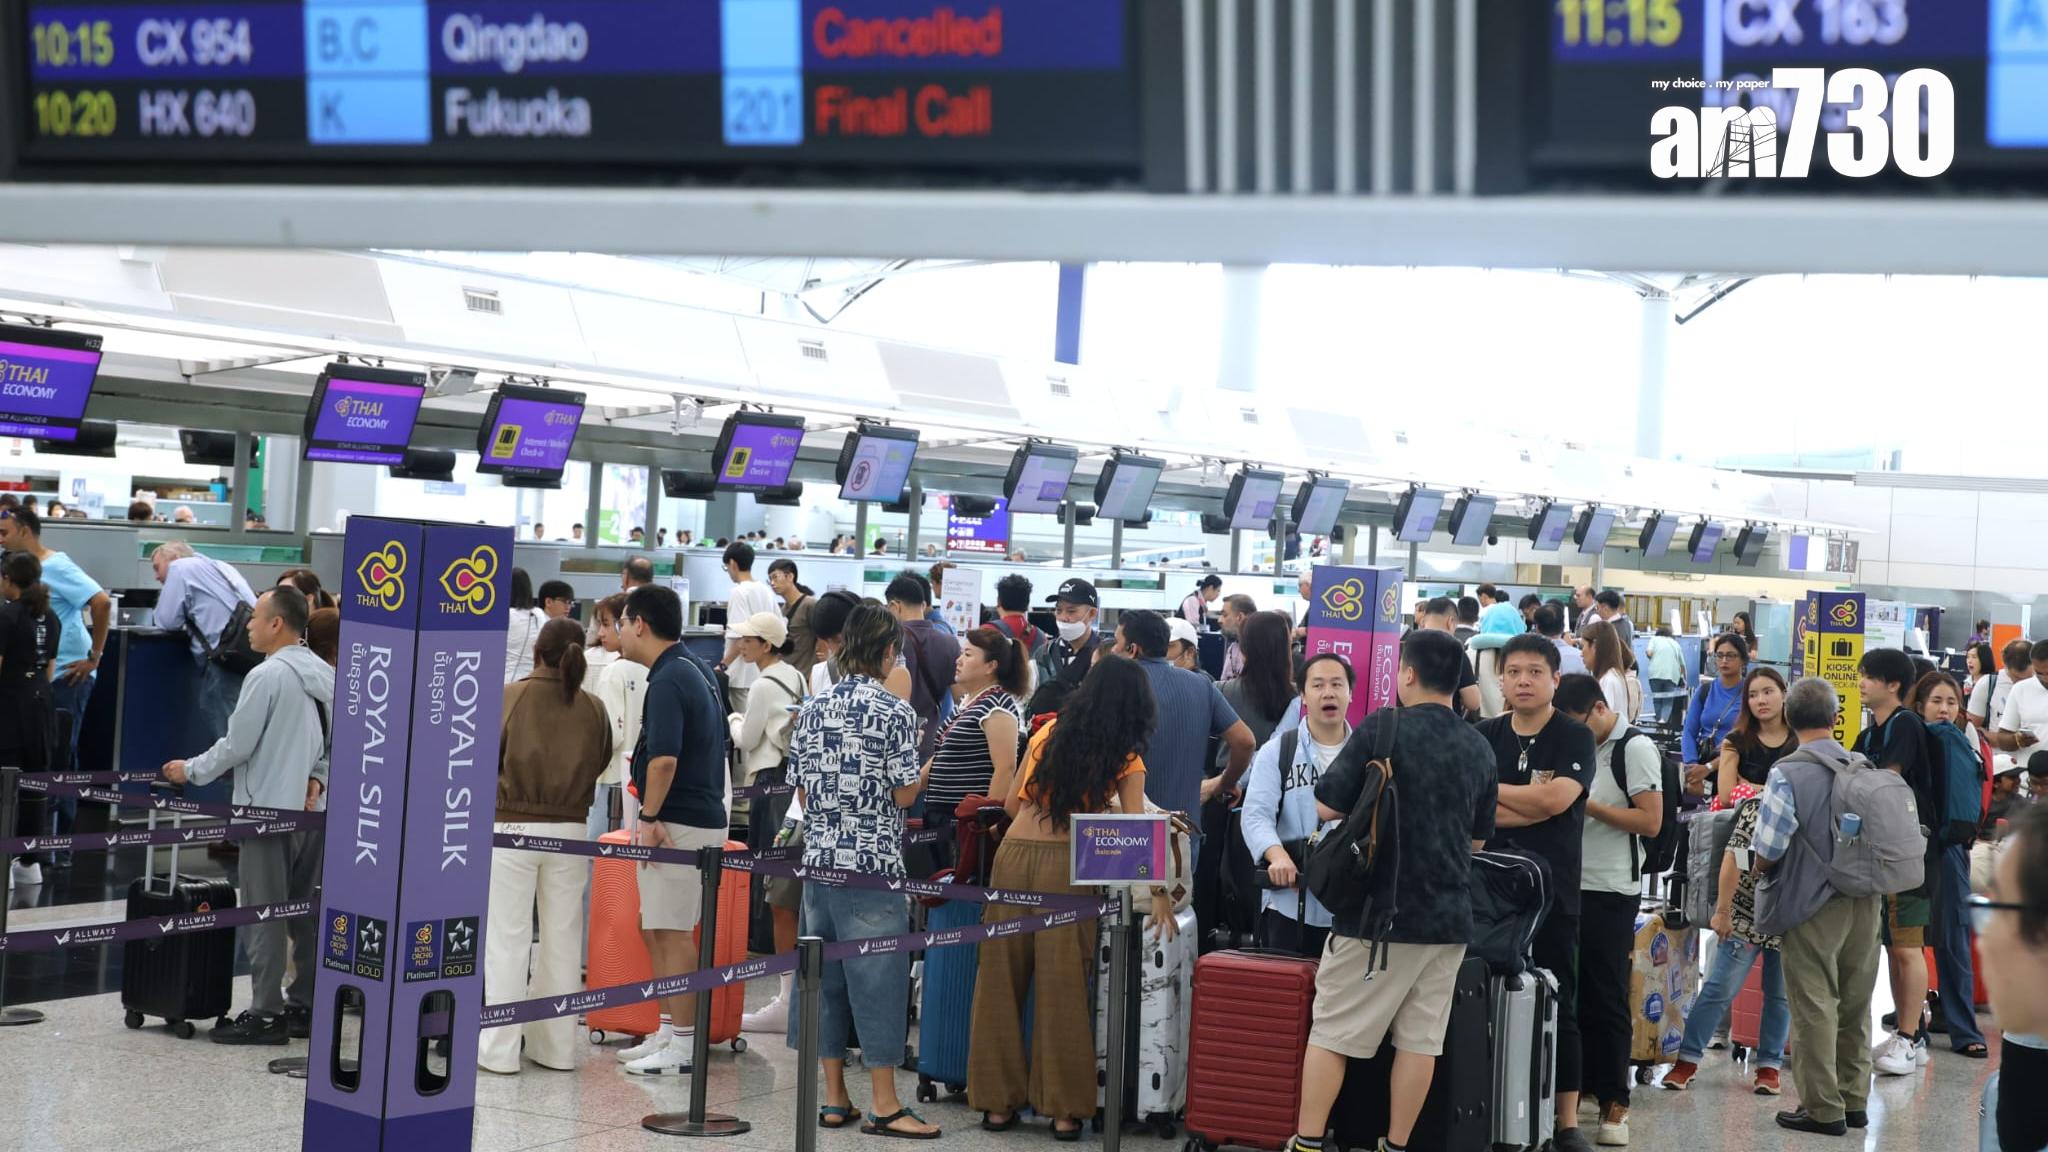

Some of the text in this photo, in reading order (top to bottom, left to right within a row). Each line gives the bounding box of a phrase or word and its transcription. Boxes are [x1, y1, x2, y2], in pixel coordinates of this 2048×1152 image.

[1558, 0, 1683, 47] 11:15
[1723, 0, 1805, 46] CX
[813, 7, 1001, 57] Cancelled
[32, 21, 114, 66] 10:15
[137, 19, 252, 64] CX 954
[442, 14, 589, 72] Qingdao
[34, 91, 116, 136] 10:20
[140, 91, 256, 136] HX 640
[318, 91, 346, 136] K
[445, 89, 592, 137] Fukuoka
[731, 88, 797, 135] 201
[814, 84, 993, 136] Final Call
[9, 365, 49, 385] THAI
[2, 383, 58, 400] ECONOMY
[352, 400, 384, 416] THAI
[346, 416, 390, 430] ECONOMY
[356, 593, 379, 608] THAI
[439, 602, 466, 615] THAI
[1321, 610, 1341, 619] THAI
[1823, 672, 1858, 681] ONLINE
[355, 644, 392, 867] ROYAL SILK
[440, 650, 481, 872] ROYAL SILK
[19, 778, 48, 788] ALLWAYS
[93, 790, 123, 800] ALLWAYS
[169, 801, 200, 810] ALLWAYS
[247, 809, 279, 818] ALLWAYS
[196, 827, 226, 836] ALLWAYS
[269, 821, 297, 830] ALLWAYS
[120, 833, 152, 842] ALLWAYS
[1096, 828, 1120, 837] THAI
[39, 838, 73, 846] ALLWAYS
[528, 838, 563, 848] ALLWAYS
[1095, 837, 1149, 847] ECONOMY
[616, 847, 651, 857] ALLWAYS
[810, 869, 848, 881] ALLWAYS
[905, 881, 943, 893] ALLWAYS
[1003, 892, 1042, 902] ALLWAYS
[274, 902, 311, 914] ALLWAYS
[178, 914, 217, 926] ALLWAYS
[1055, 910, 1077, 921] ALLWAYS
[74, 927, 117, 939] ALLWAYS
[997, 921, 1021, 932] ALLWAYS
[936, 931, 962, 941] ALLWAYS
[871, 938, 898, 949] ALLWAYS
[325, 957, 350, 971] Platinum
[444, 964, 473, 977] GOLD
[736, 961, 767, 975] ALLWAYS
[356, 963, 381, 979] GOLD
[406, 970, 436, 981] Platinum
[657, 977, 689, 990] ALLWAYS
[571, 992, 606, 1006] ALLWAYS
